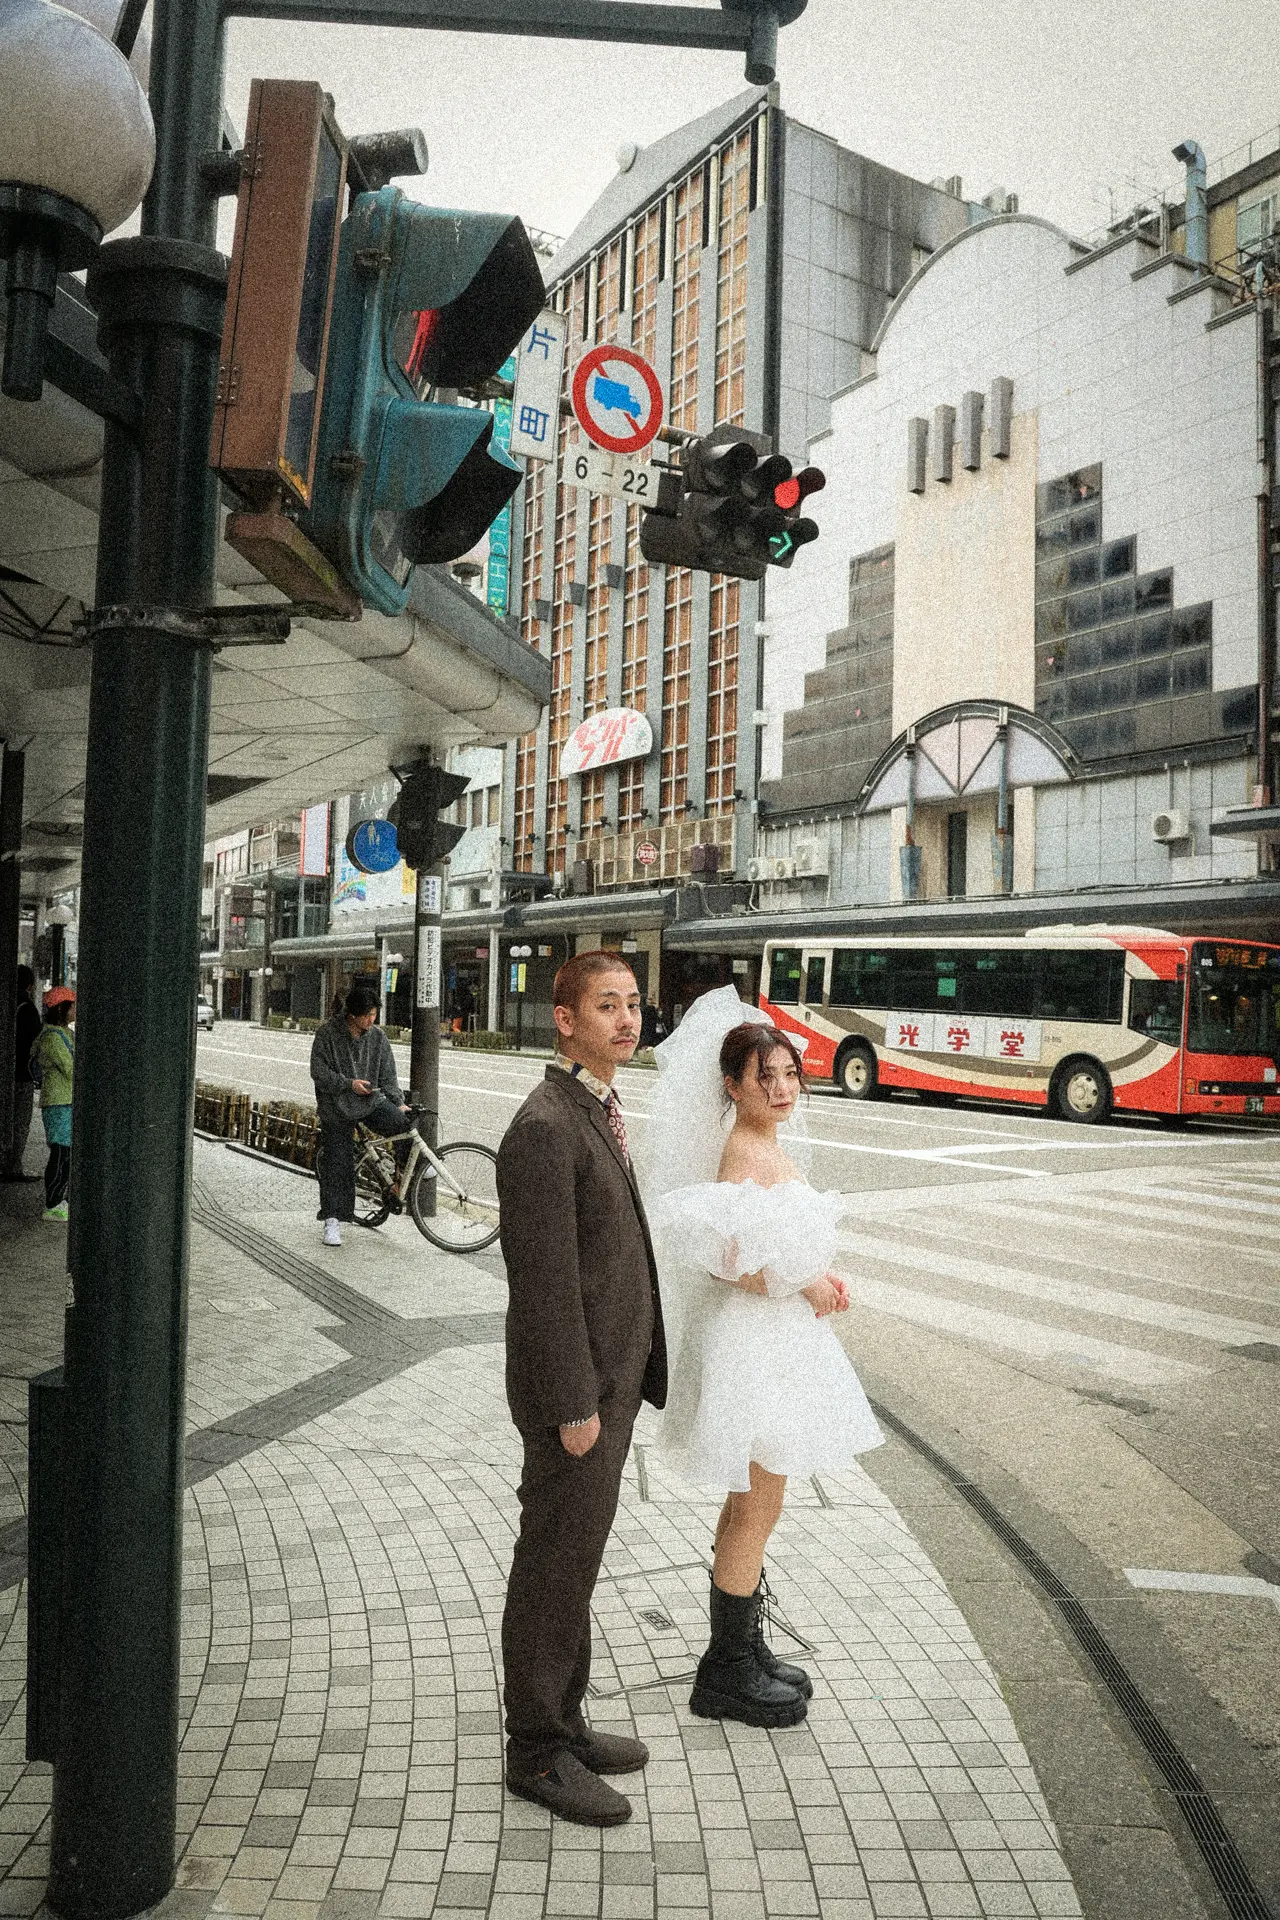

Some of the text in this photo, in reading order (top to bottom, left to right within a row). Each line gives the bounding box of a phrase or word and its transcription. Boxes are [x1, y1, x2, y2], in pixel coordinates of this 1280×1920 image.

[519, 323, 558, 442] 片町
[899, 1023, 1025, 1057] 光学堂
